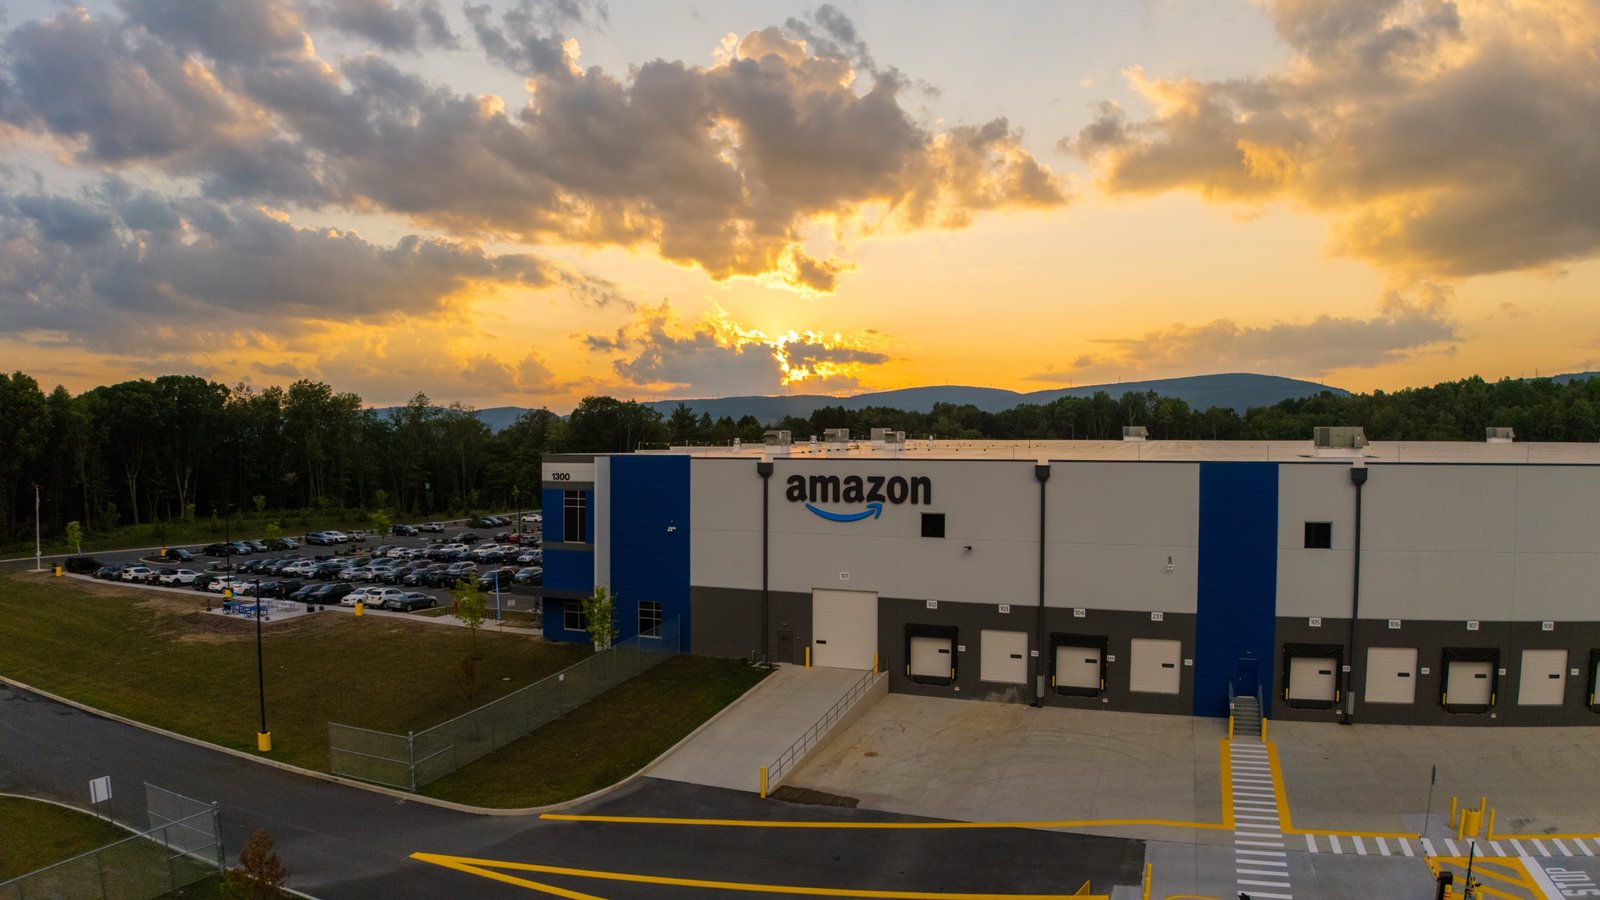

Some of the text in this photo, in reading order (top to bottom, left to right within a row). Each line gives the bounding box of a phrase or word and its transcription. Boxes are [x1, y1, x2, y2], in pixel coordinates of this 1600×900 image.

[552, 472, 570, 481] 1300
[785, 474, 931, 505] amazon
[1544, 867, 1600, 897] STOP
